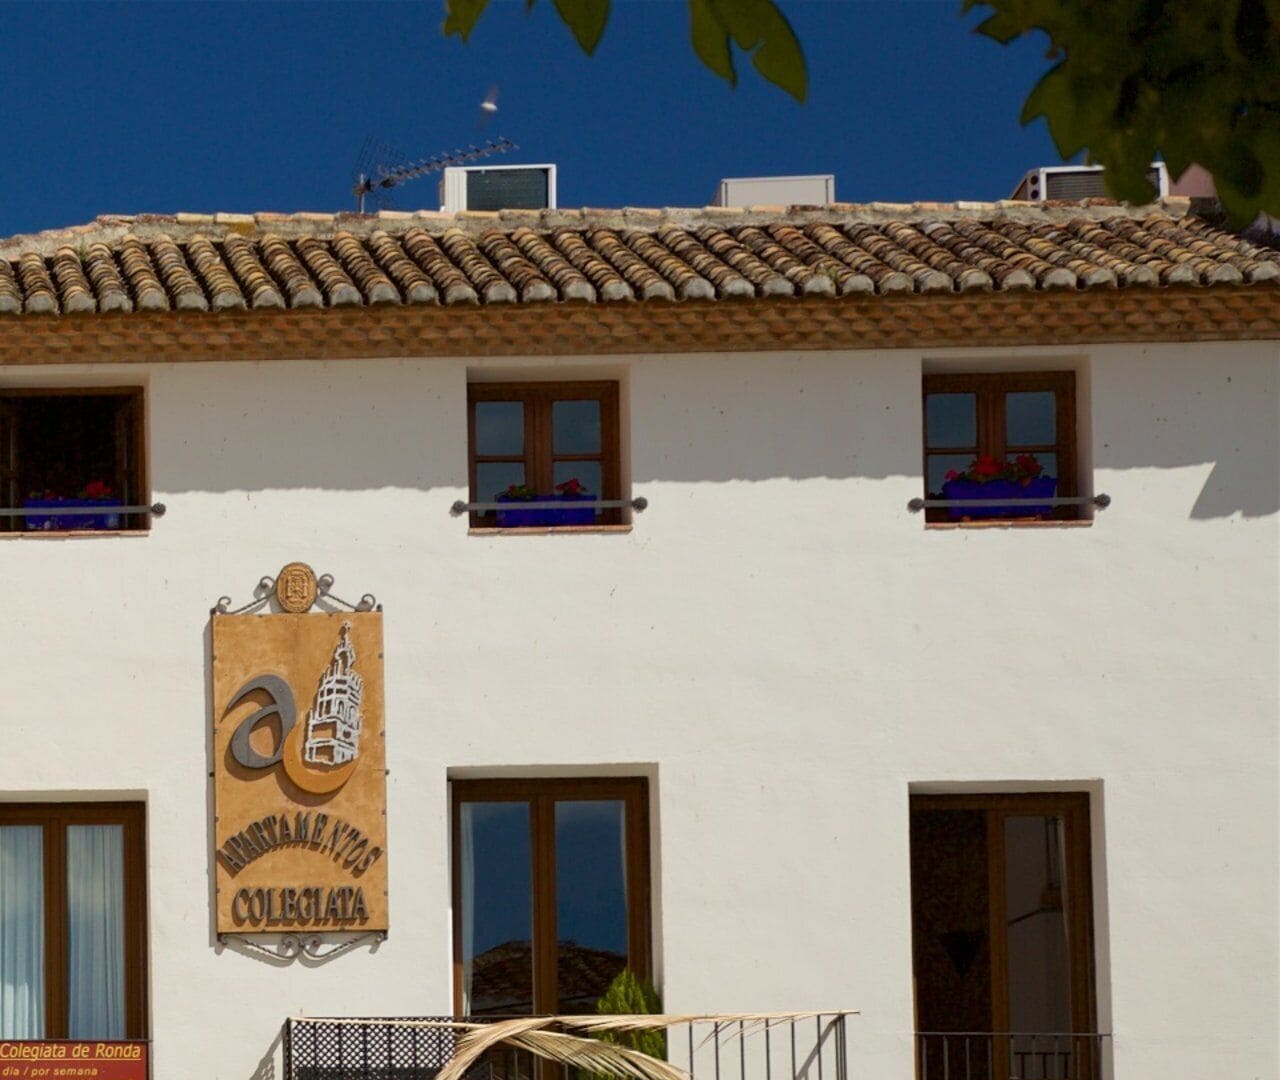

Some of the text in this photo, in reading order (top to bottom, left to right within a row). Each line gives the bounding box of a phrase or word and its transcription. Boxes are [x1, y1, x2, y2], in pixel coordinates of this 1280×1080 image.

[220, 811, 382, 874] APARTAMENTOS
[235, 887, 369, 921] COLEGIATA
[0, 1043, 66, 1061] Colegiata
[72, 1043, 90, 1058] de
[95, 1043, 141, 1058] Ronda
[31, 1067, 50, 1078] por
[53, 1067, 98, 1076] semana
